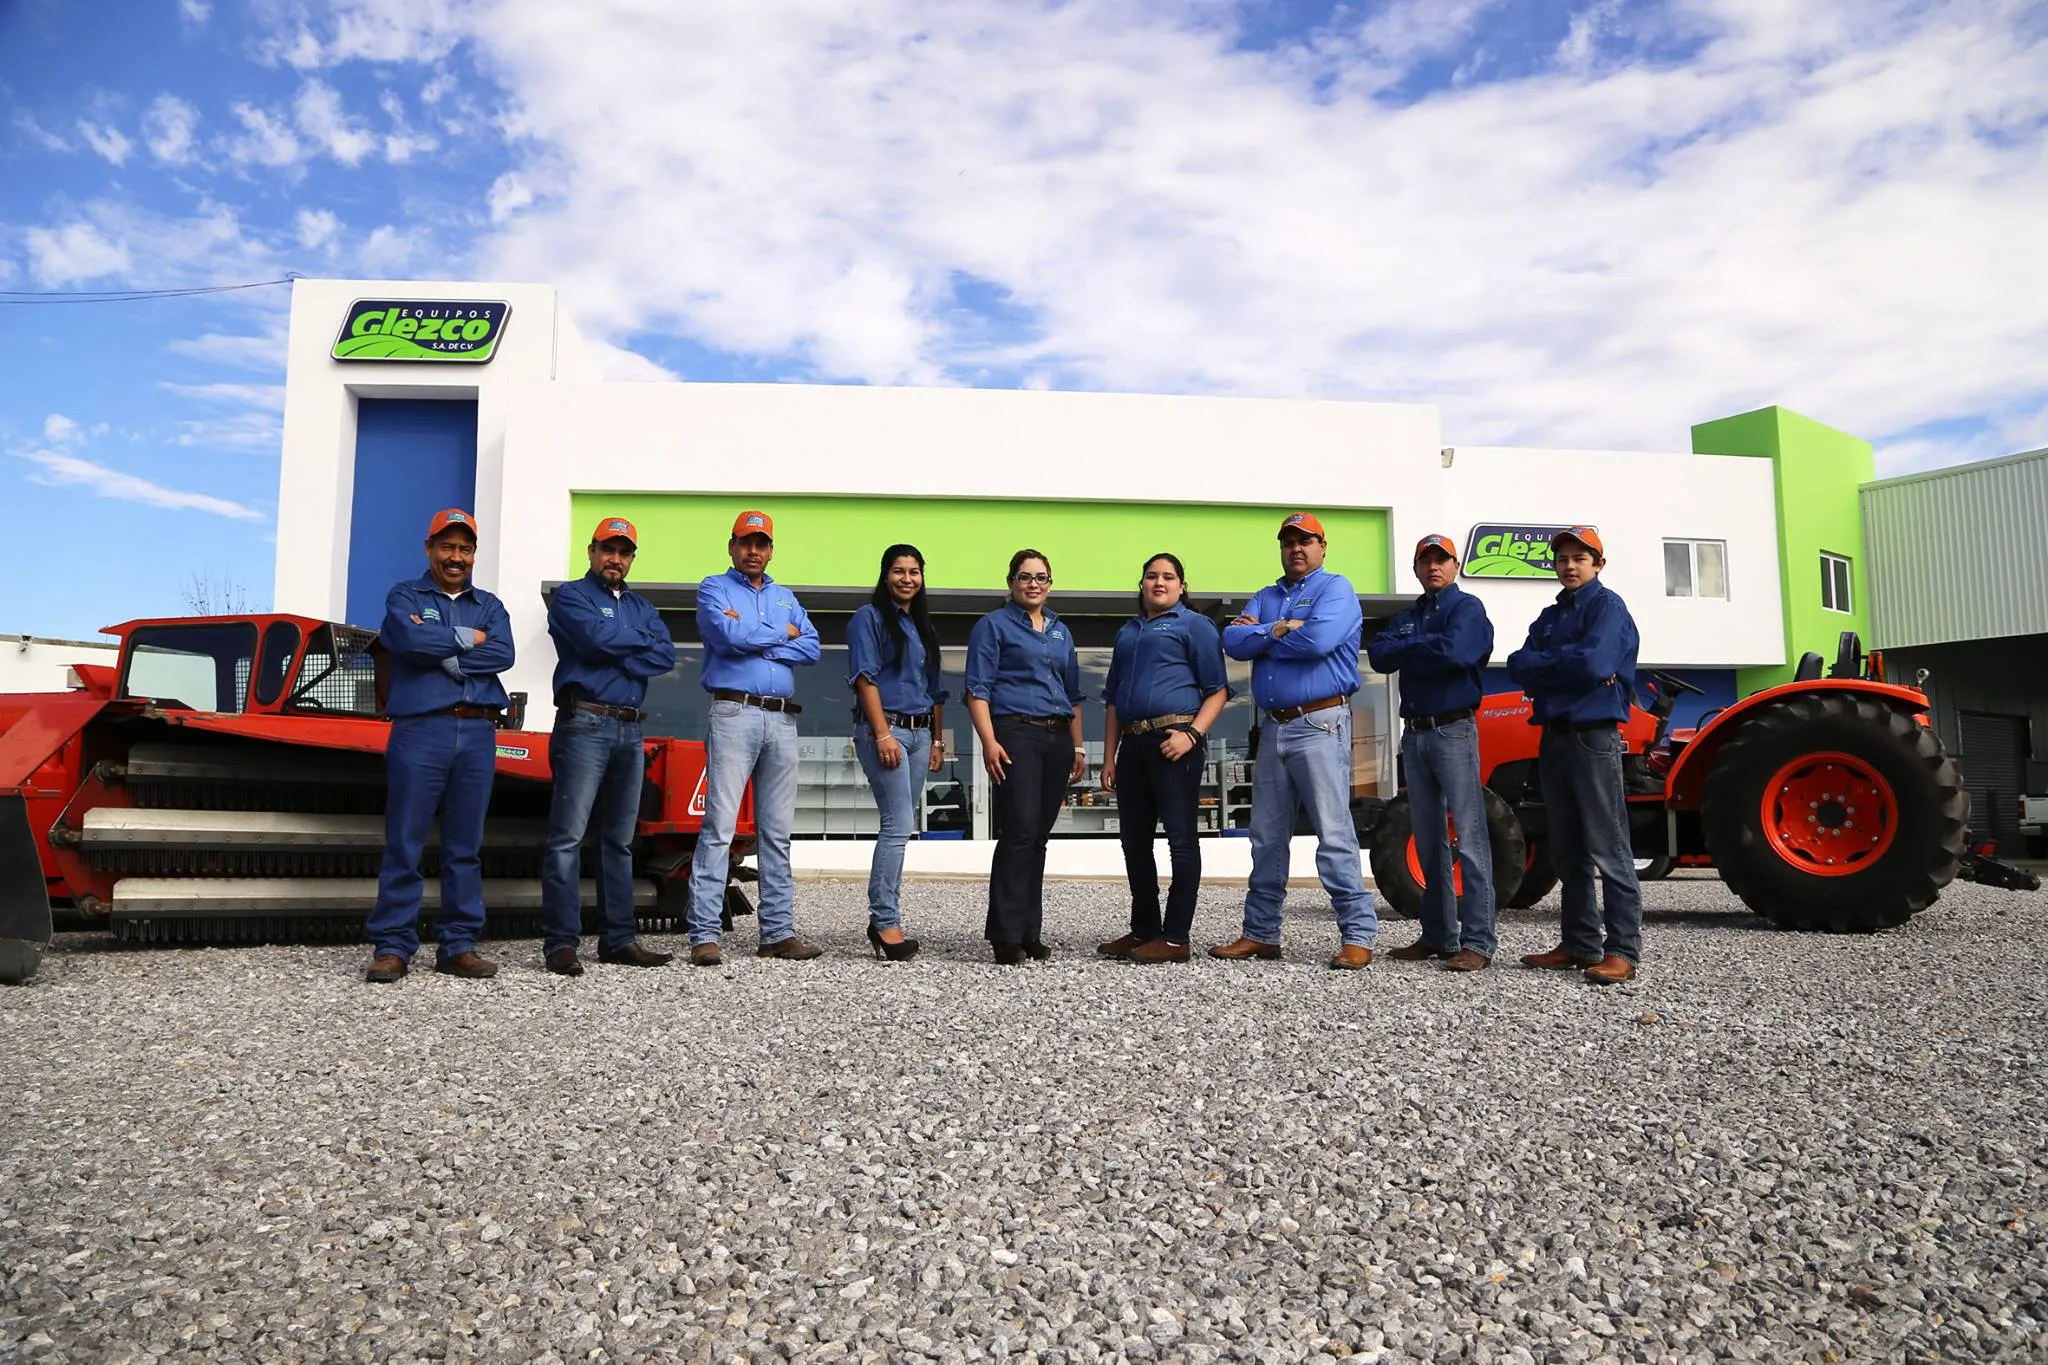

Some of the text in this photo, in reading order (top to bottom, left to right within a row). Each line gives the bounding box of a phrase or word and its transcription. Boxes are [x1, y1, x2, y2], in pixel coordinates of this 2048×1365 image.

[401, 309, 491, 319] EQUIPOS
[351, 307, 491, 342] Glezco
[1476, 532, 1554, 561] Glez
[1514, 533, 1552, 541] EQUI
